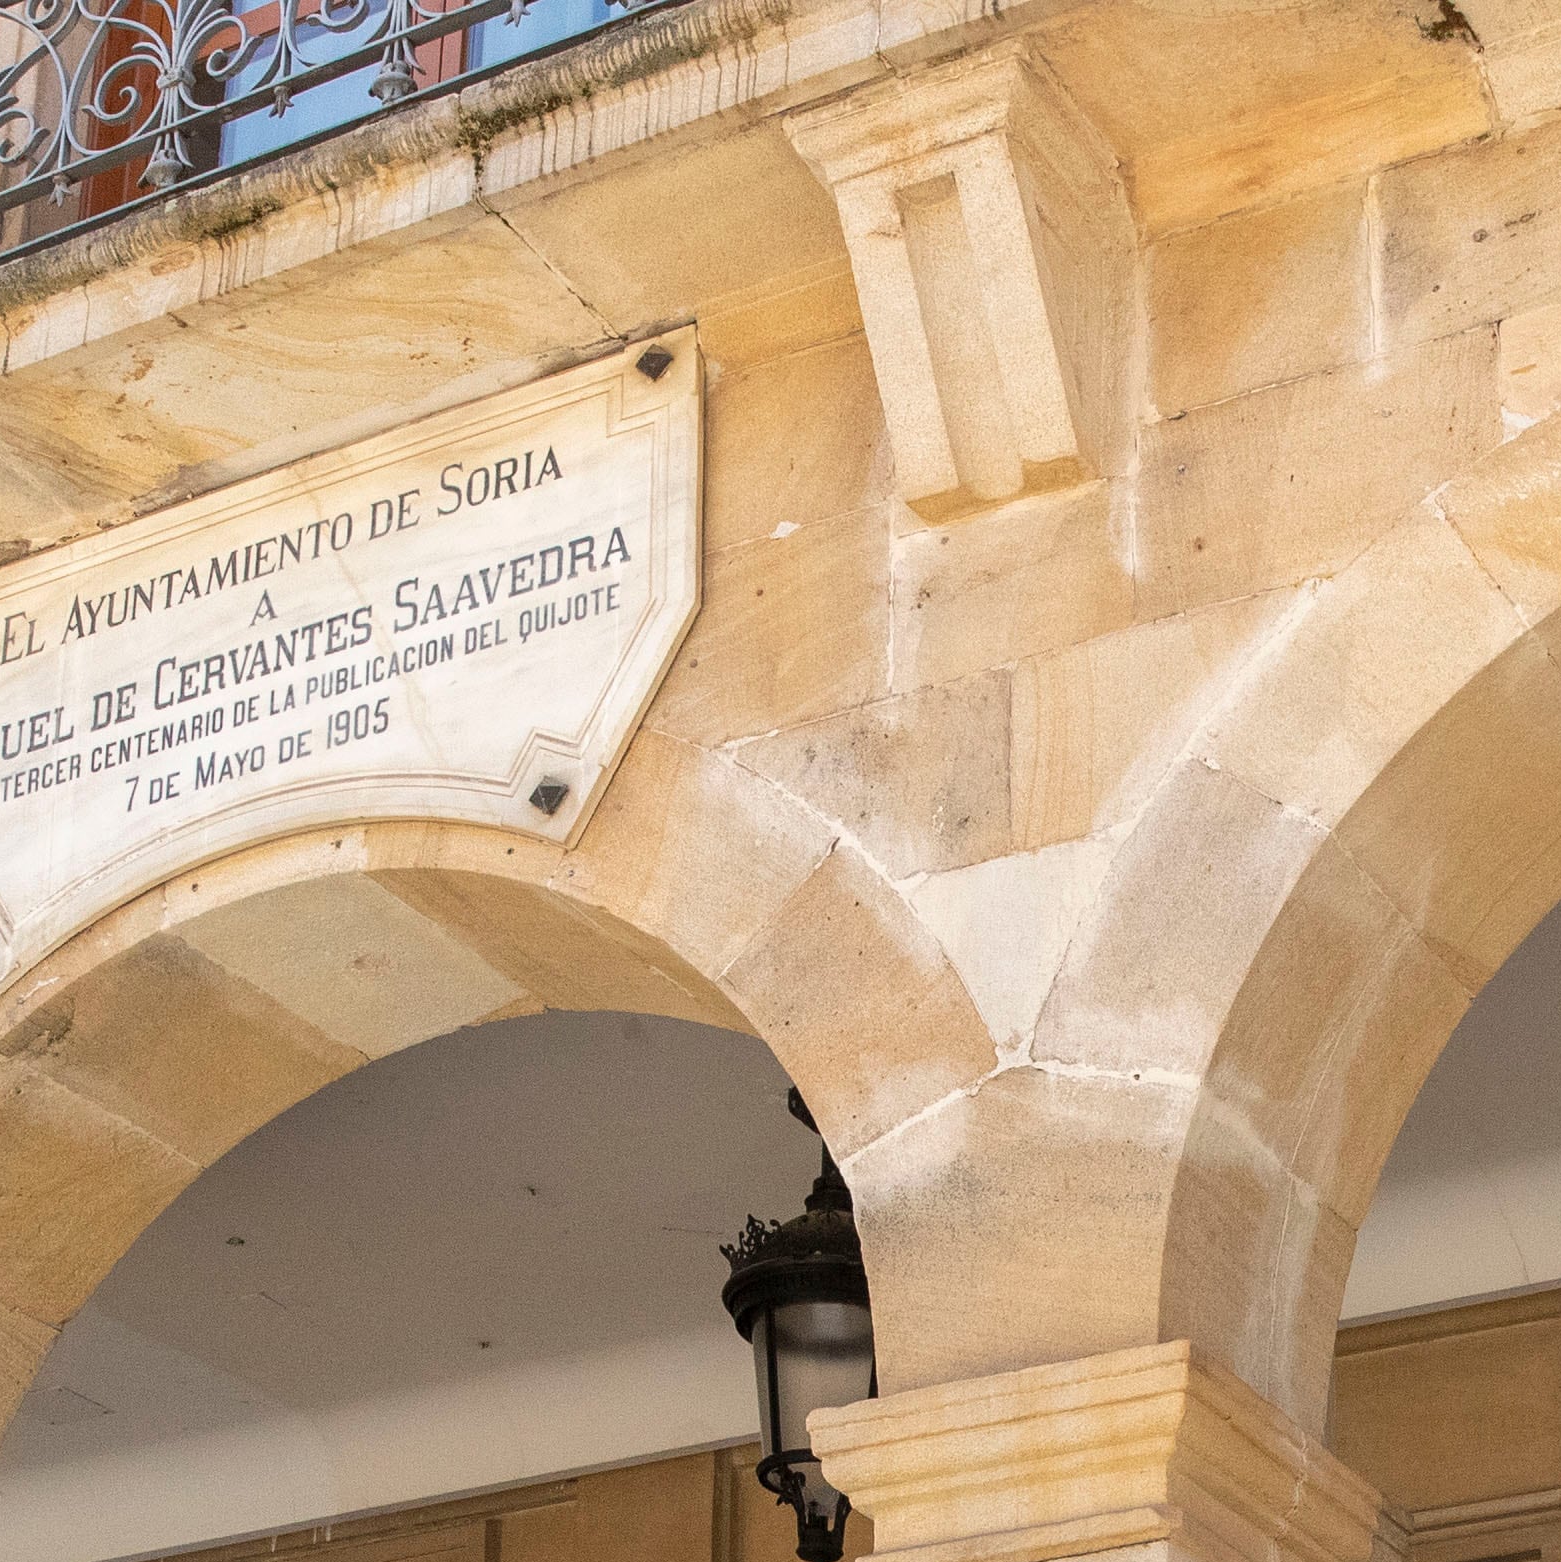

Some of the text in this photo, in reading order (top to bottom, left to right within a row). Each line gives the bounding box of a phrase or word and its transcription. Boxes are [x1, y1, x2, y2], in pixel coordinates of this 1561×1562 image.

[0, 445, 563, 665] EL AYUNTAMIENTO DE SORIA
[90, 682, 137, 732] DE
[154, 605, 373, 710] CERVANTES
[394, 526, 631, 633] SAAVEDRA
[249, 589, 278, 628] A
[1, 753, 81, 802] TERCER
[91, 707, 223, 773] CENTENARIO
[233, 695, 260, 727] DE
[270, 684, 295, 716] LA
[306, 634, 453, 705] PUBLICACION
[465, 619, 508, 655] DEL
[519, 583, 620, 643] QUIJOTE
[125, 697, 390, 812] 7 DE MAYO DE 1905
